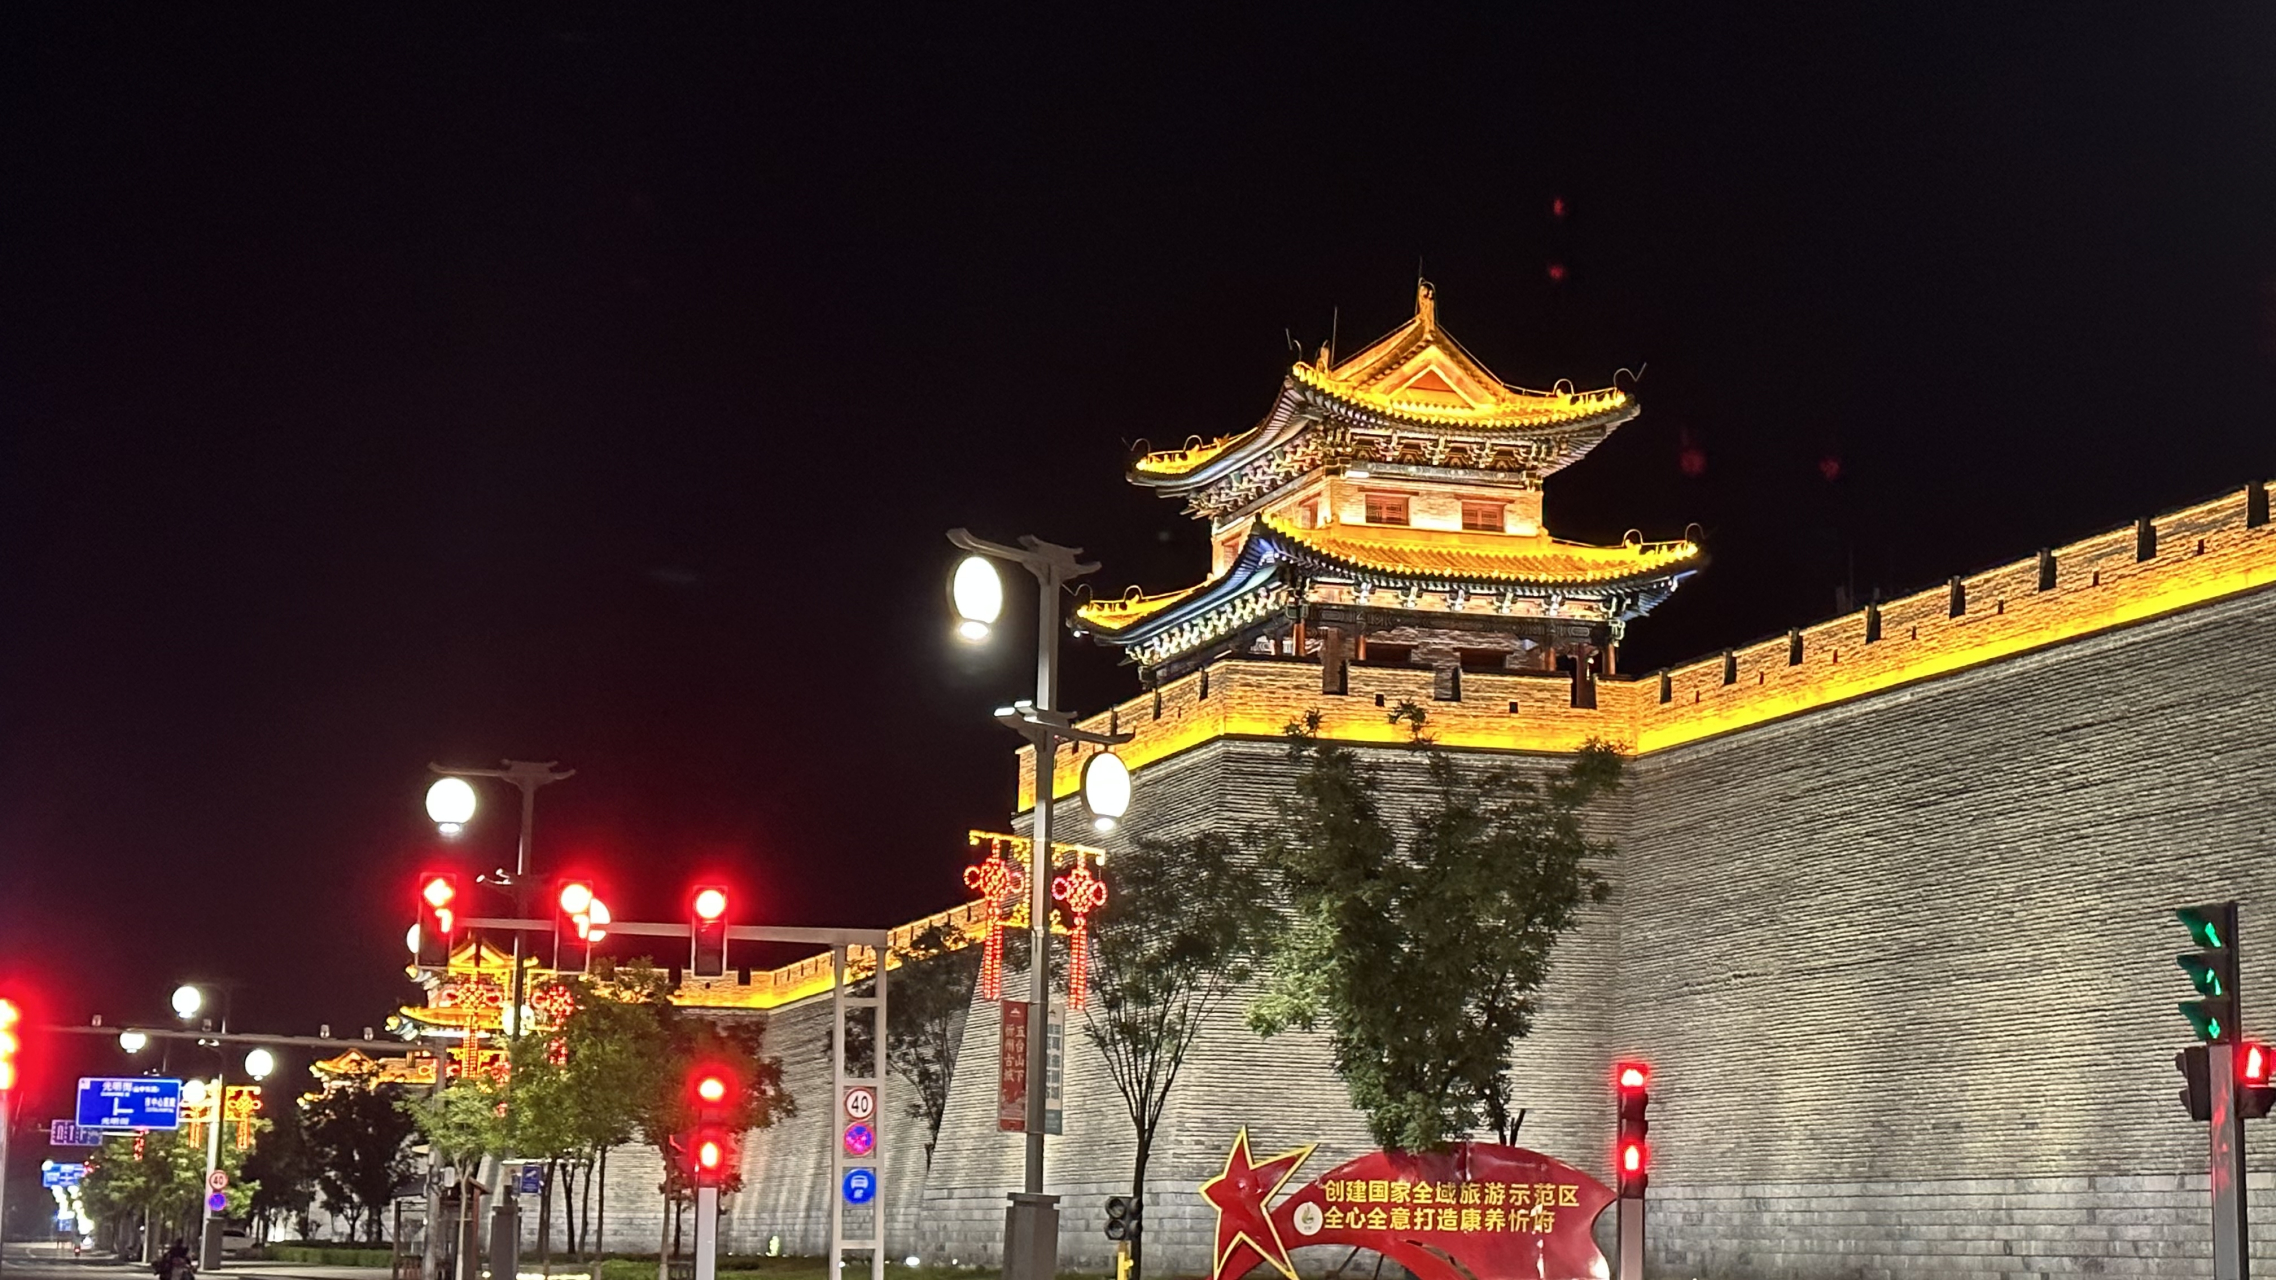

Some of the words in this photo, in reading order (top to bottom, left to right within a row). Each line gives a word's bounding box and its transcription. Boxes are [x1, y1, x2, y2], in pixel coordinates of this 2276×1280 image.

[1004, 1024, 1015, 1082] 忻州古城
[1015, 1026, 1026, 1083] 五台山下
[851, 1095, 869, 1113] 40
[213, 1175, 224, 1185] 40
[1324, 1180, 1580, 1207] 创建国家全域旅游示范区
[1324, 1205, 1556, 1233] 全心全意打造康养忻府
